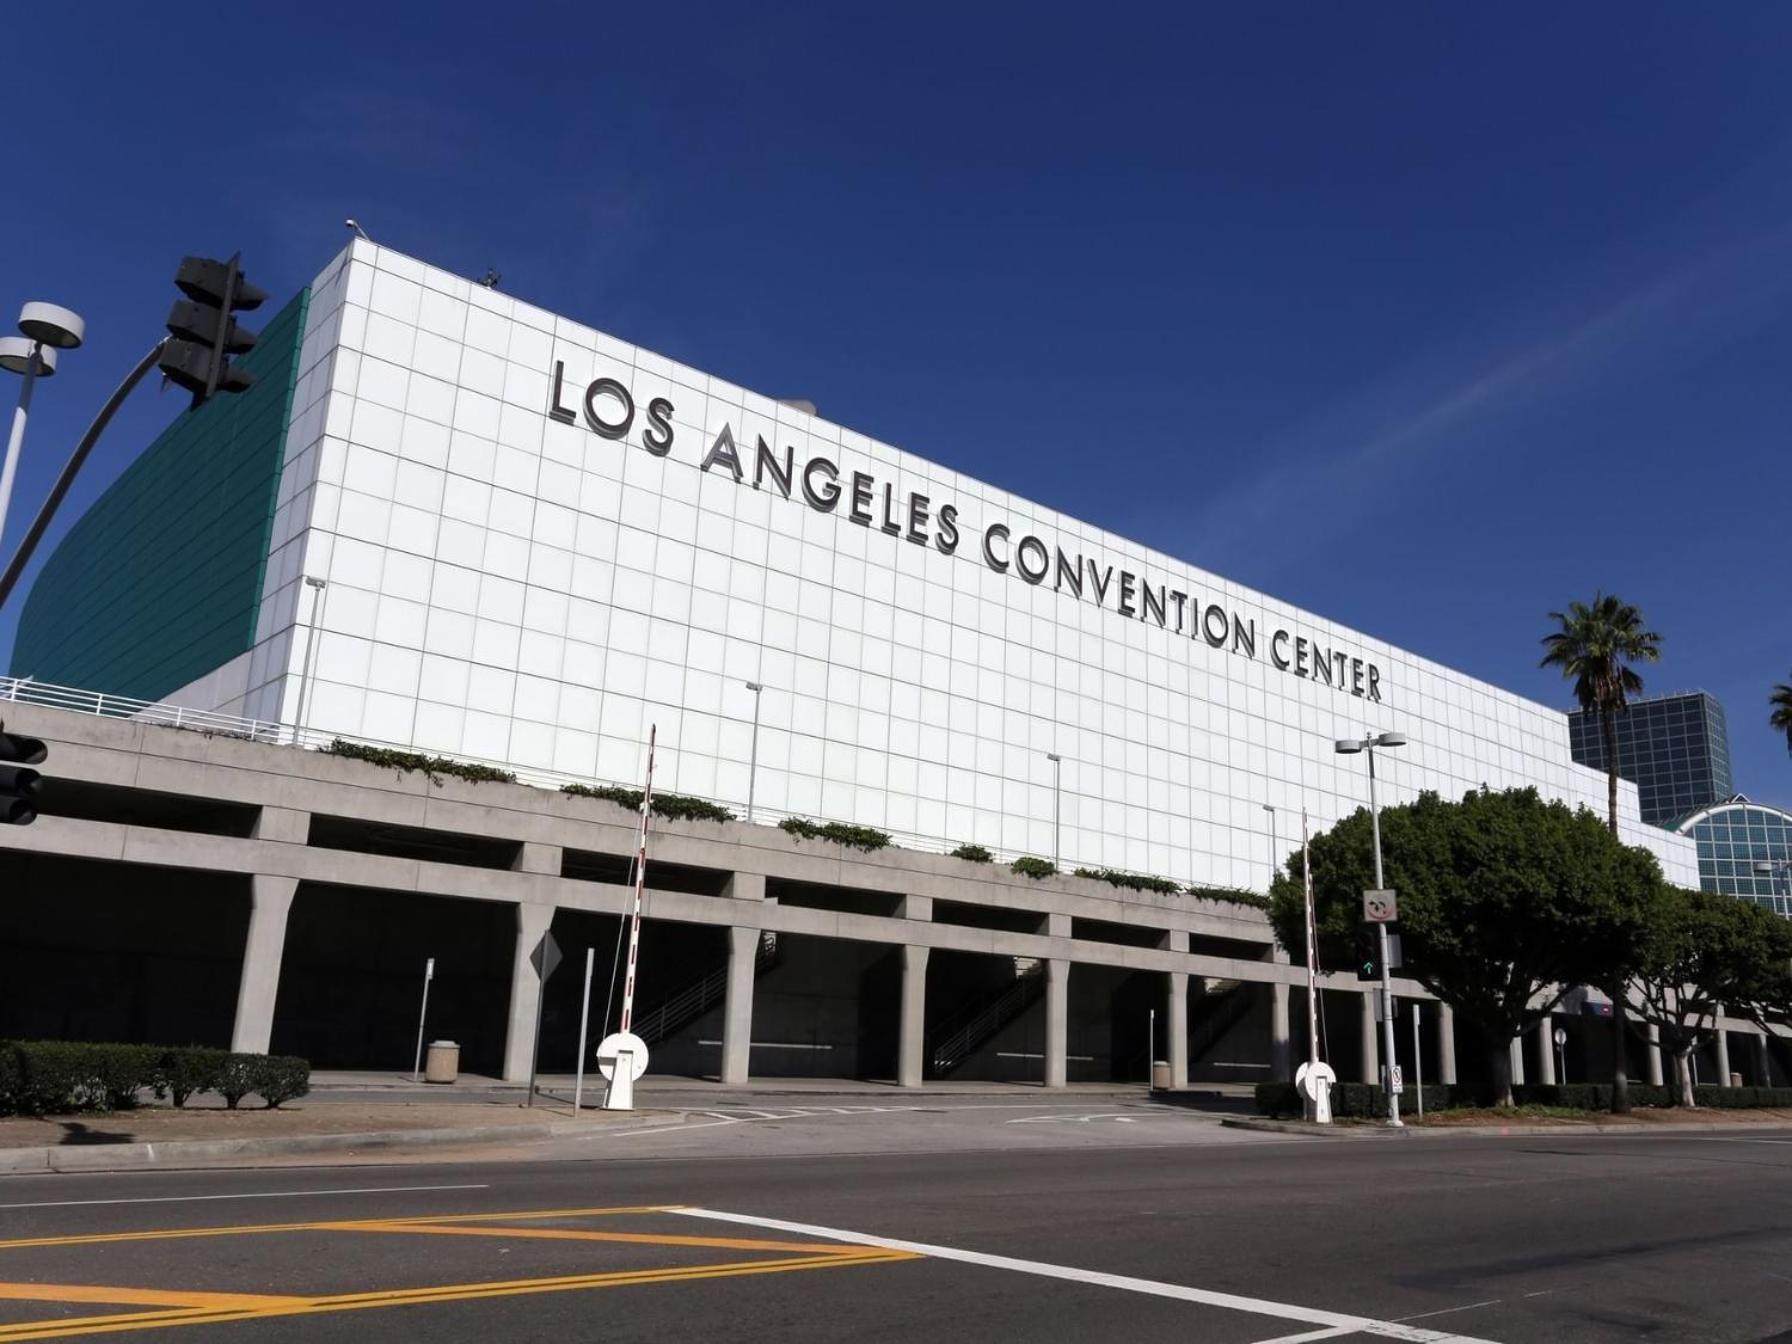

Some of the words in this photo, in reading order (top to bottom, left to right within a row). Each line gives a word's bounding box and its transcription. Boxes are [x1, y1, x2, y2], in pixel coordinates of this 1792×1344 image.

[549, 360, 675, 457] LOS
[701, 422, 959, 555] ANGELES
[982, 523, 1255, 660] CONVENTION
[1270, 629, 1382, 704] CENTER
